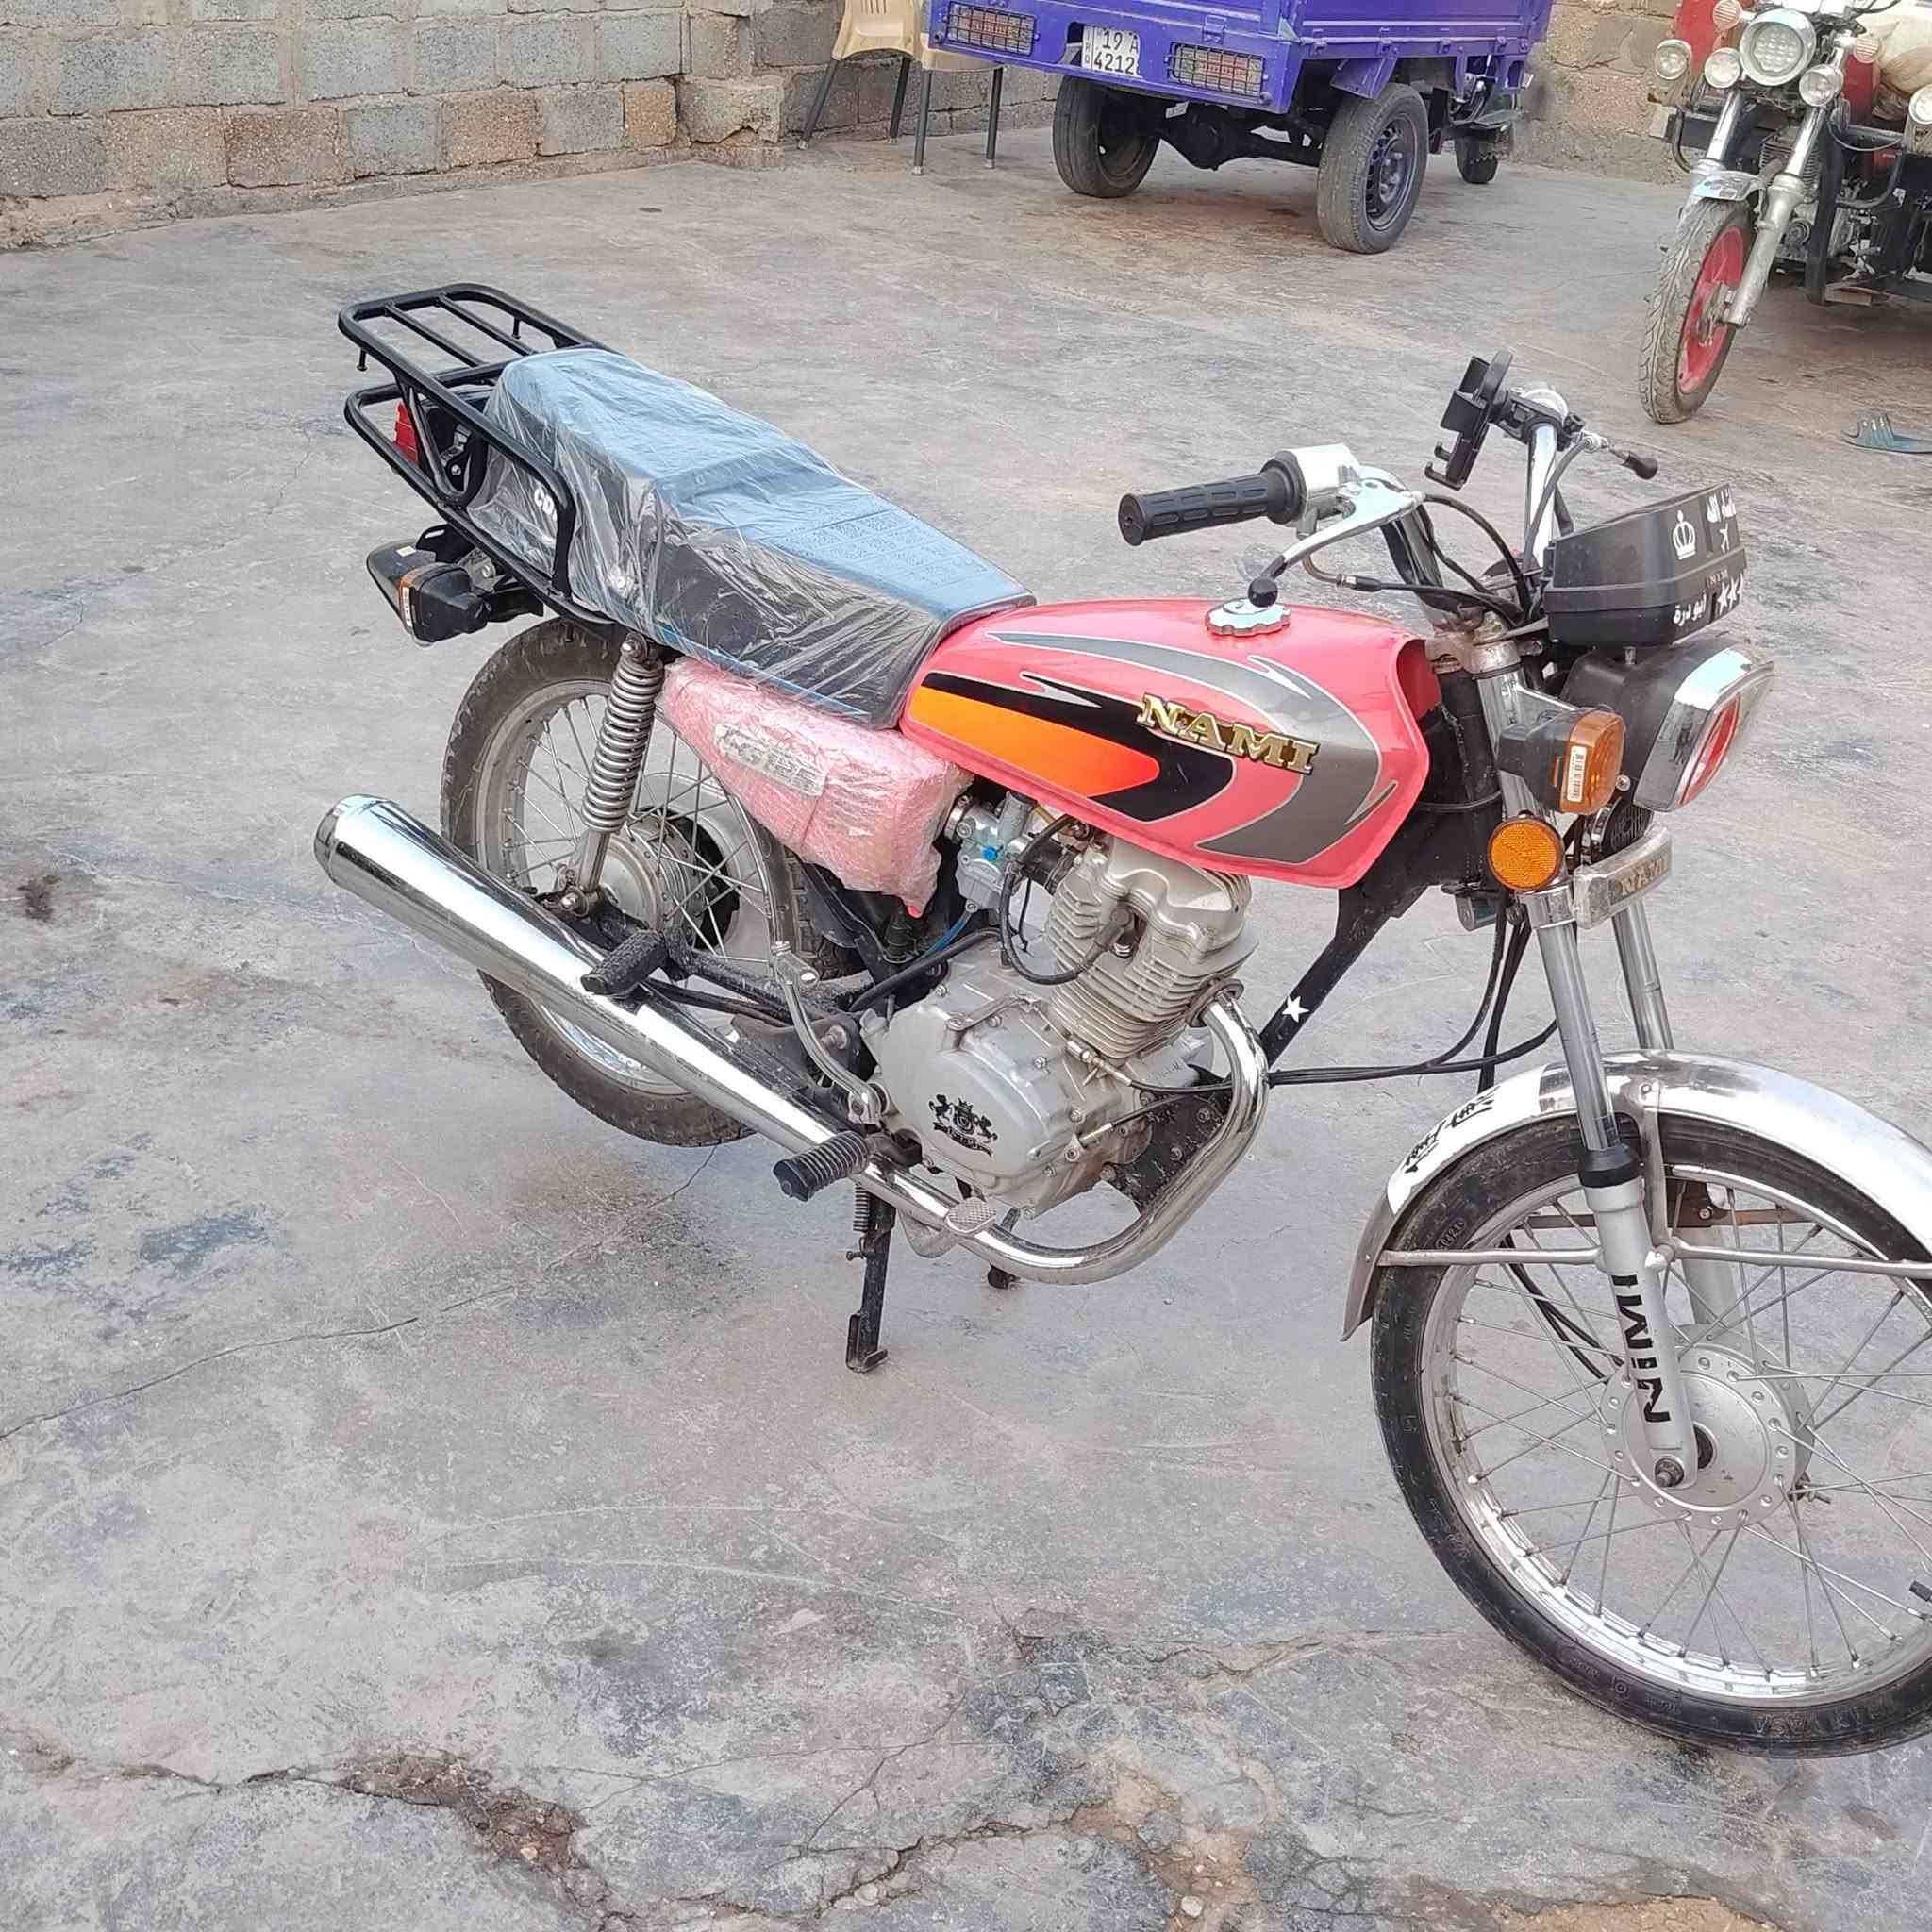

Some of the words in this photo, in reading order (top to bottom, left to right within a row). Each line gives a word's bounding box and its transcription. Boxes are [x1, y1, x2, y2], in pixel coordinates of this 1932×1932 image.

[1102, 29, 1123, 50] 19
[1094, 51, 1136, 75] 4212
[1136, 693, 1321, 774] NAMI
